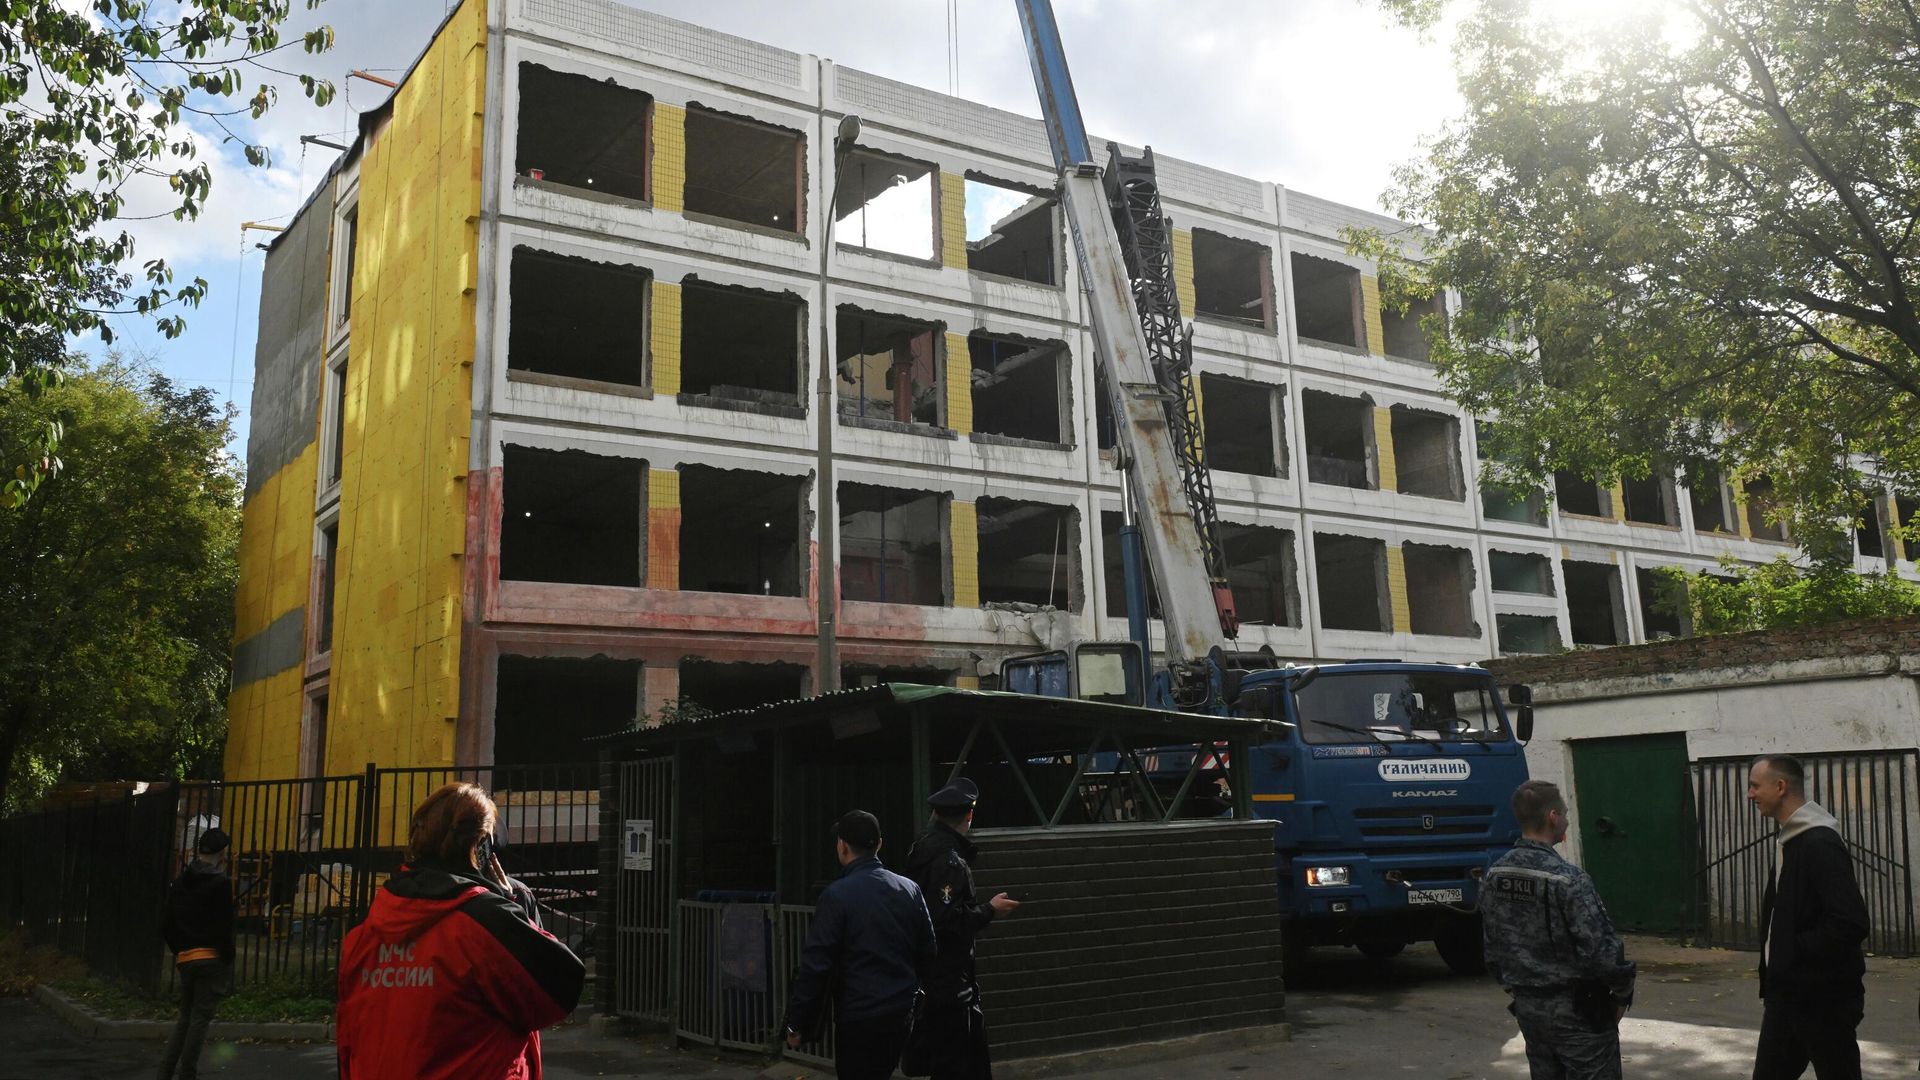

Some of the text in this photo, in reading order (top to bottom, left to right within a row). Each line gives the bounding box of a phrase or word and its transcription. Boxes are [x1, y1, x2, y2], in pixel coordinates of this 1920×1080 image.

[1382, 763, 1467, 775] ГАЛИЧАНИН
[1392, 789, 1458, 798] KAMAZ
[379, 942, 417, 963] МЧС
[361, 966, 434, 988] РОССИИ
